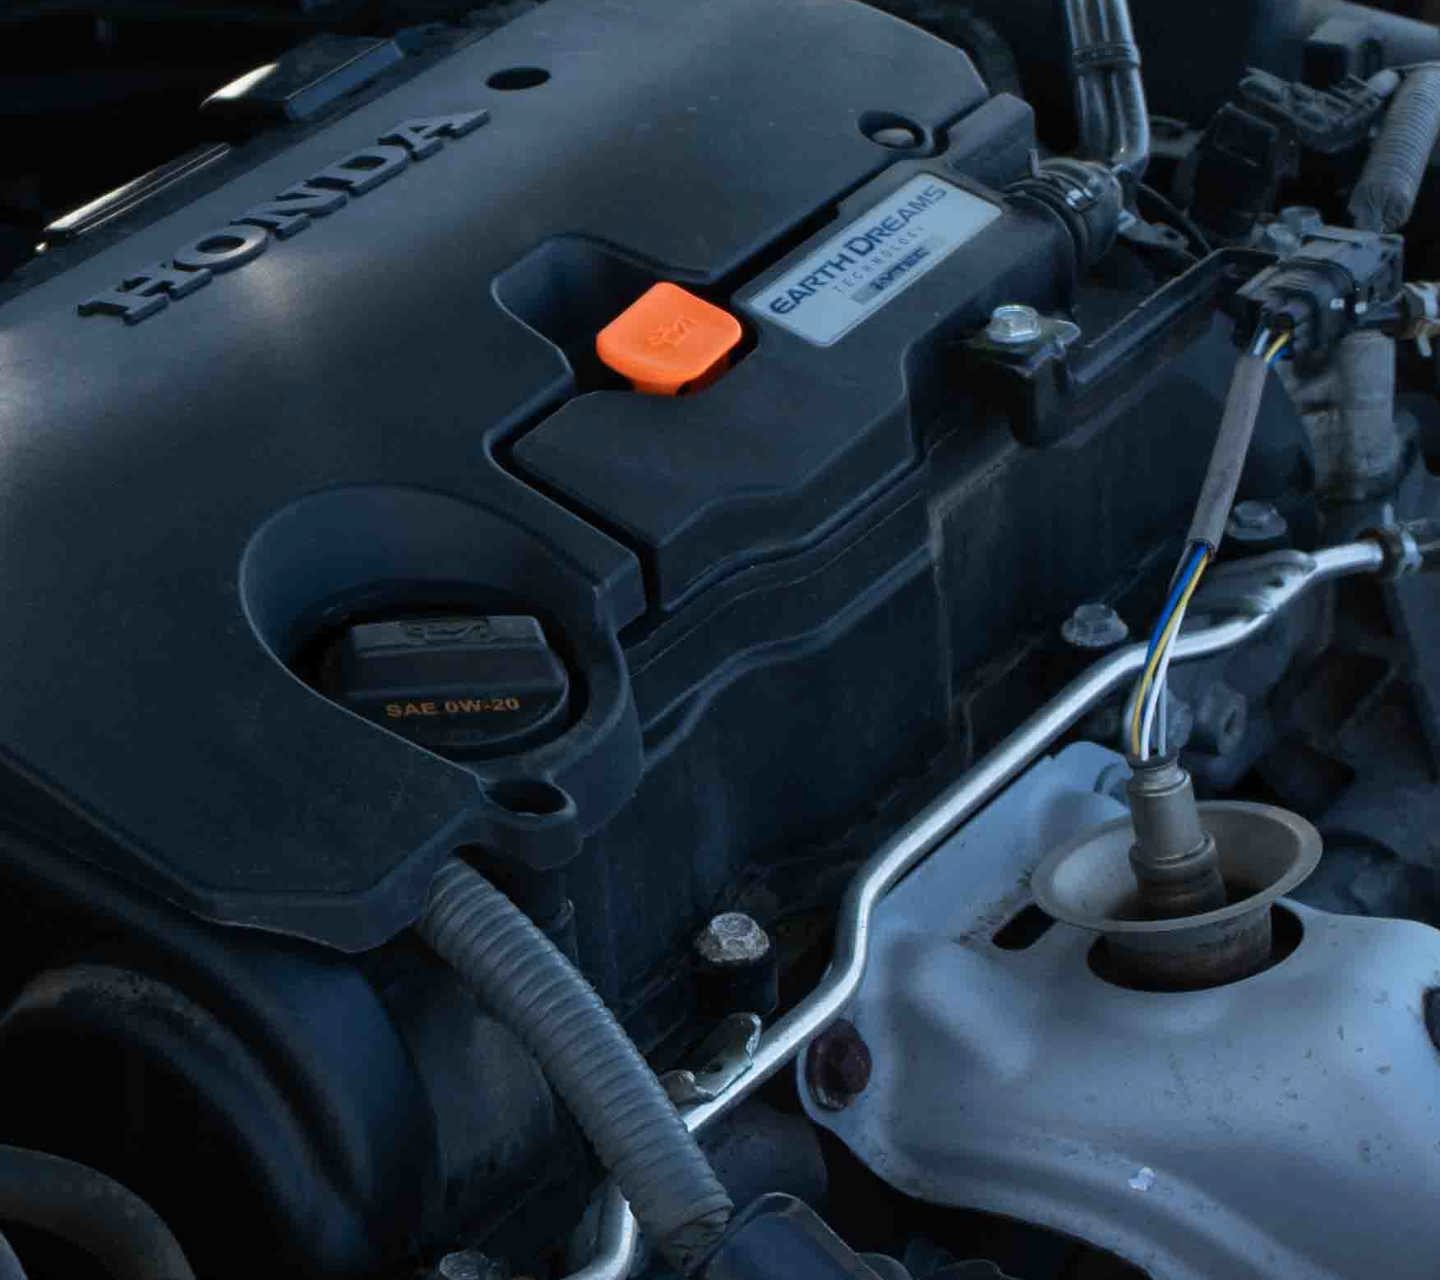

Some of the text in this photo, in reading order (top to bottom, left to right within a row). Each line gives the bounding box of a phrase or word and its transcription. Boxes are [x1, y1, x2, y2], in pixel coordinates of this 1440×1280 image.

[77, 108, 490, 326] HONDA
[769, 184, 946, 315] EARTH DREAMS
[386, 697, 520, 719] SAE 0W-20
